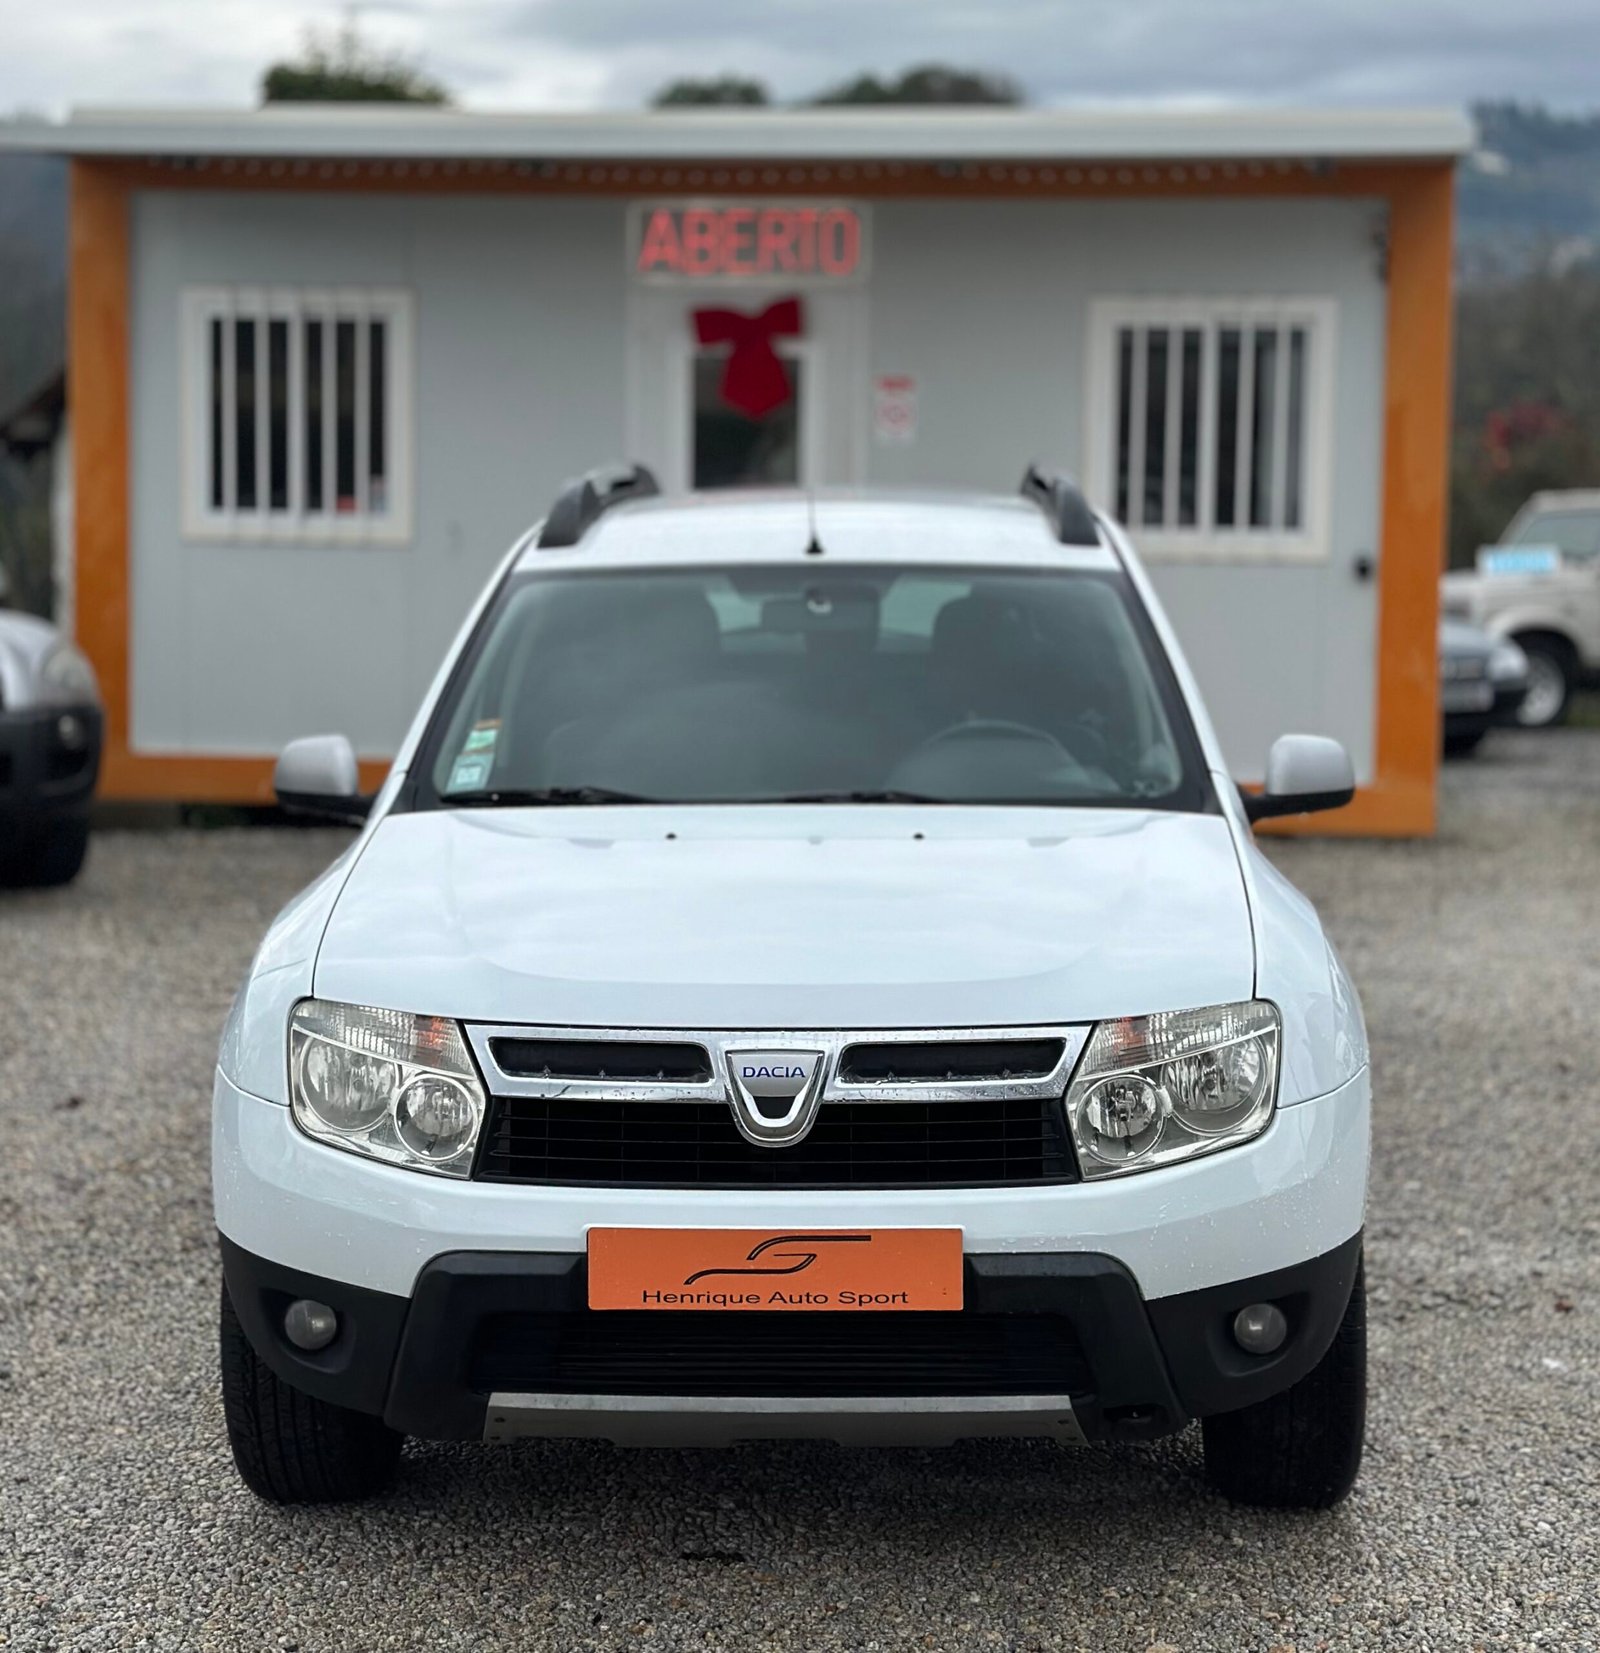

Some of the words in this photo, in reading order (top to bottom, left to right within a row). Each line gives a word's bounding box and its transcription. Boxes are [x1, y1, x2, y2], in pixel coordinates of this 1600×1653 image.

[638, 207, 861, 277] ABERTO
[742, 1066, 806, 1078] DACIA
[642, 1290, 761, 1307] Henrique
[767, 1291, 829, 1305] Auto
[838, 1291, 909, 1307] Sport
